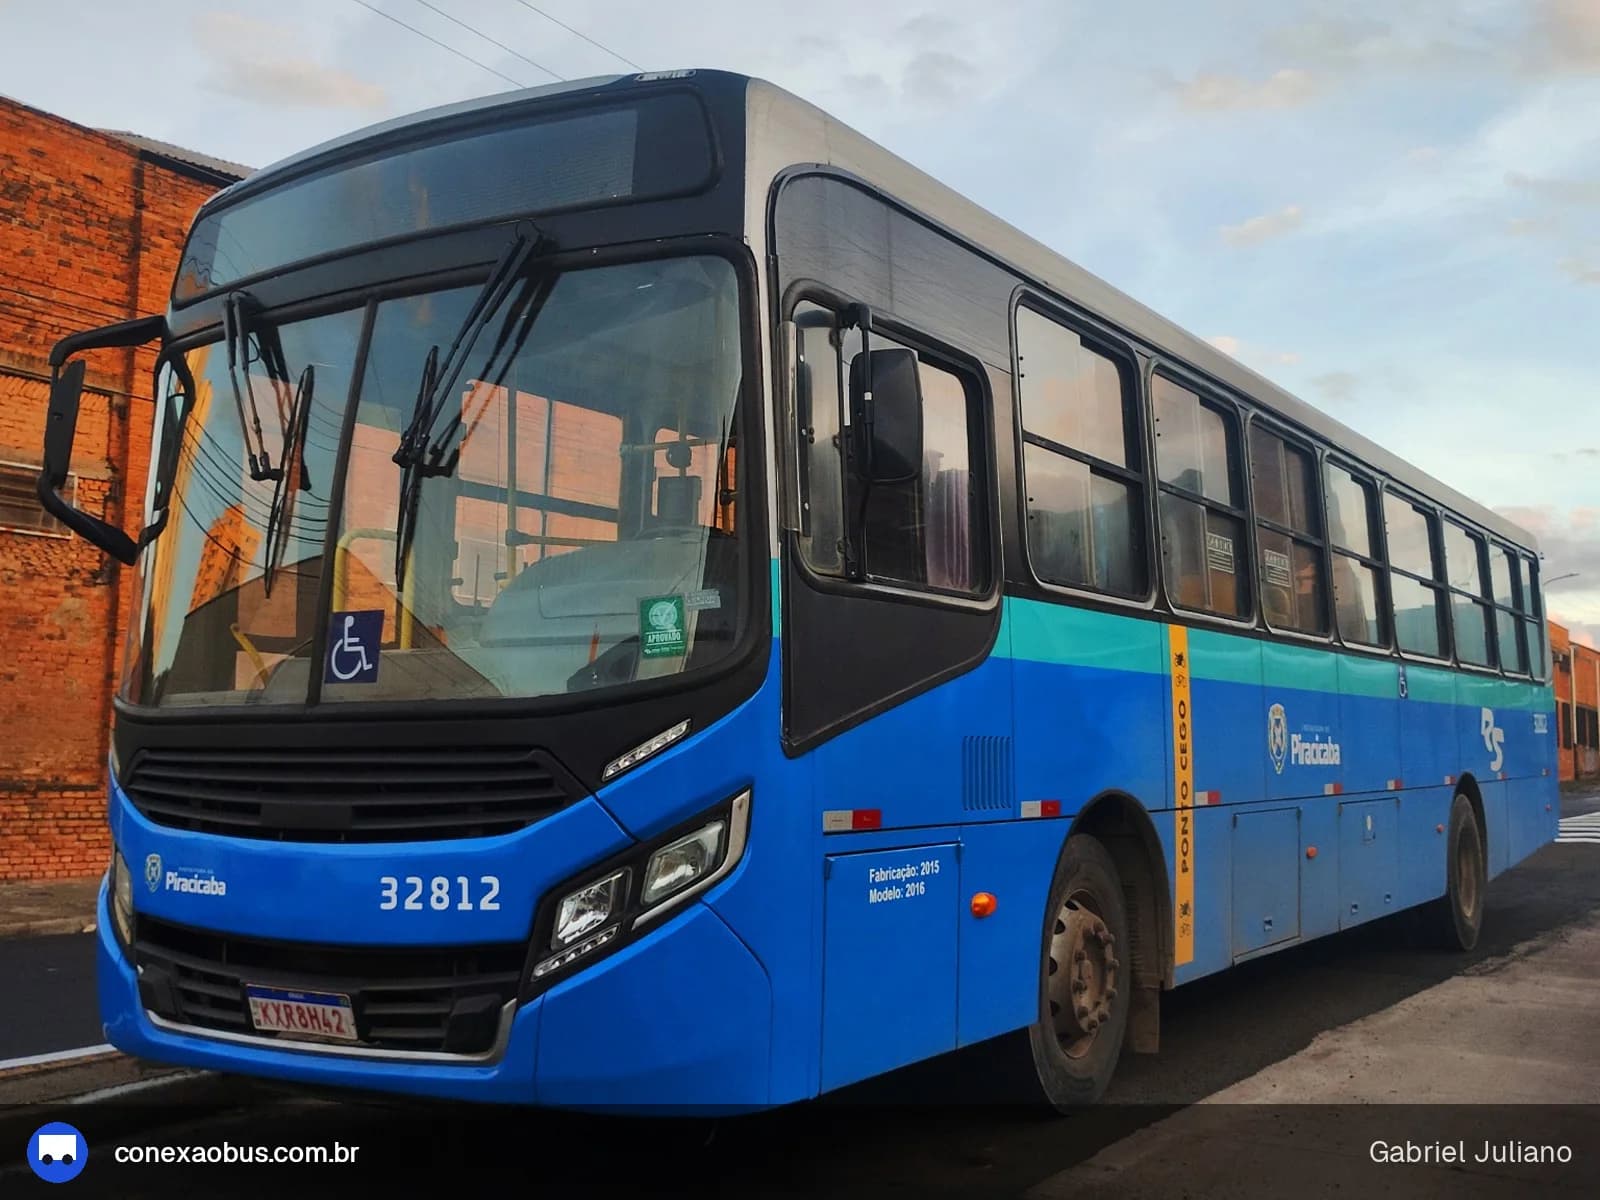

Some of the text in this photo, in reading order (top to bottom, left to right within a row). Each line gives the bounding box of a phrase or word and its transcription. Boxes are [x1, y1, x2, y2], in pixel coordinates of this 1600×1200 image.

[647, 632, 681, 643] APROVADO
[1291, 733, 1340, 765] Piracicaba
[1178, 700, 1189, 873] PONTO CEGO
[165, 871, 226, 896] Piracicaba
[869, 860, 940, 883] Fabricação: 2015
[380, 876, 500, 910] 32812
[869, 881, 926, 904] Modelo: 2016
[259, 1001, 345, 1034] KXR8H42
